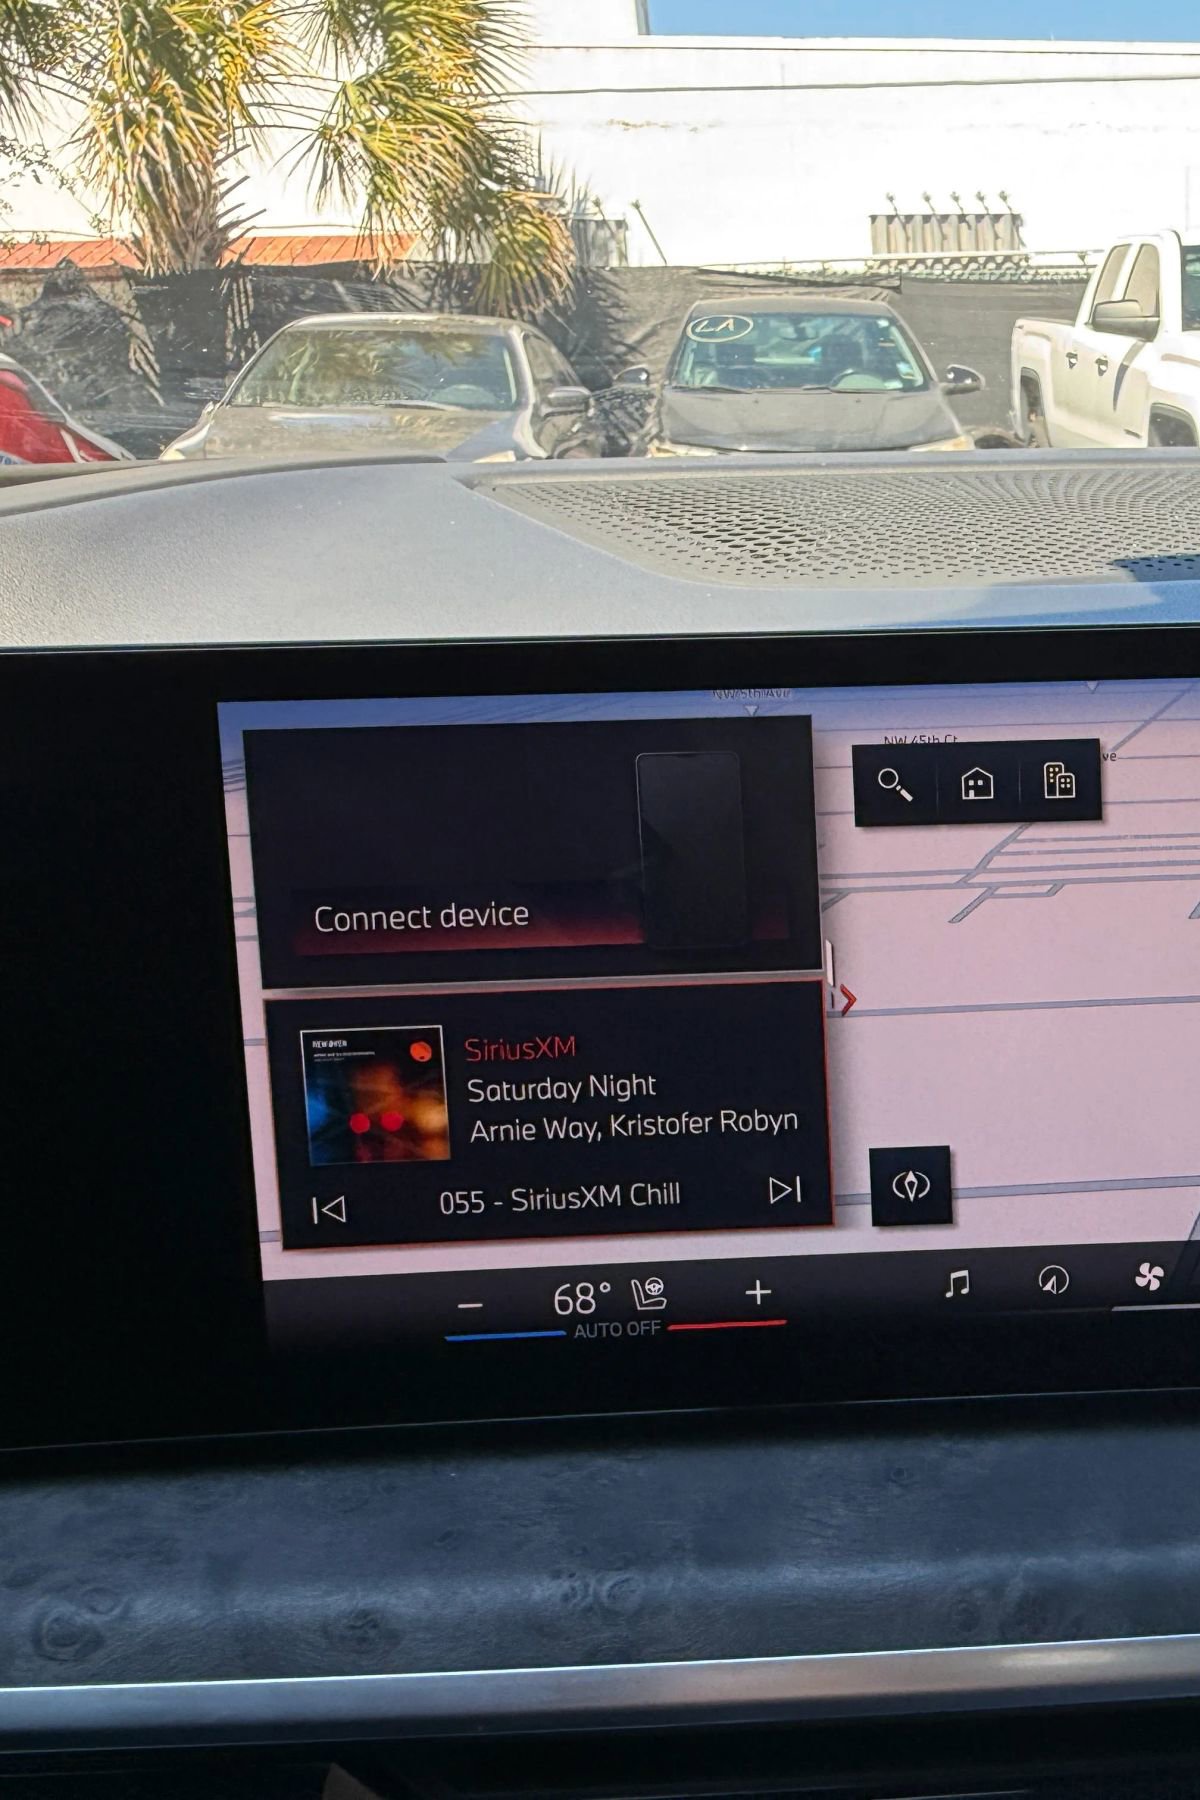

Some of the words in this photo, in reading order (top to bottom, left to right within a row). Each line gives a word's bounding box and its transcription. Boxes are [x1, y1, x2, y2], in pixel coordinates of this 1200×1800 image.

[1102, 753, 1117, 762] ve
[314, 905, 432, 932] Connect
[440, 901, 530, 928] device
[464, 1036, 576, 1062] SiriusXM
[467, 1077, 582, 1103] Saturday
[590, 1074, 657, 1100] Night
[470, 1117, 535, 1142] Arnie
[543, 1115, 602, 1144] Way,
[610, 1110, 714, 1138] Kristofer
[721, 1108, 798, 1133] Robyn
[439, 1190, 485, 1215] 055
[511, 1185, 622, 1212] SiriusXM
[630, 1181, 681, 1207] Chill
[574, 1320, 622, 1338] AUTO
[624, 1319, 662, 1337] OFF
